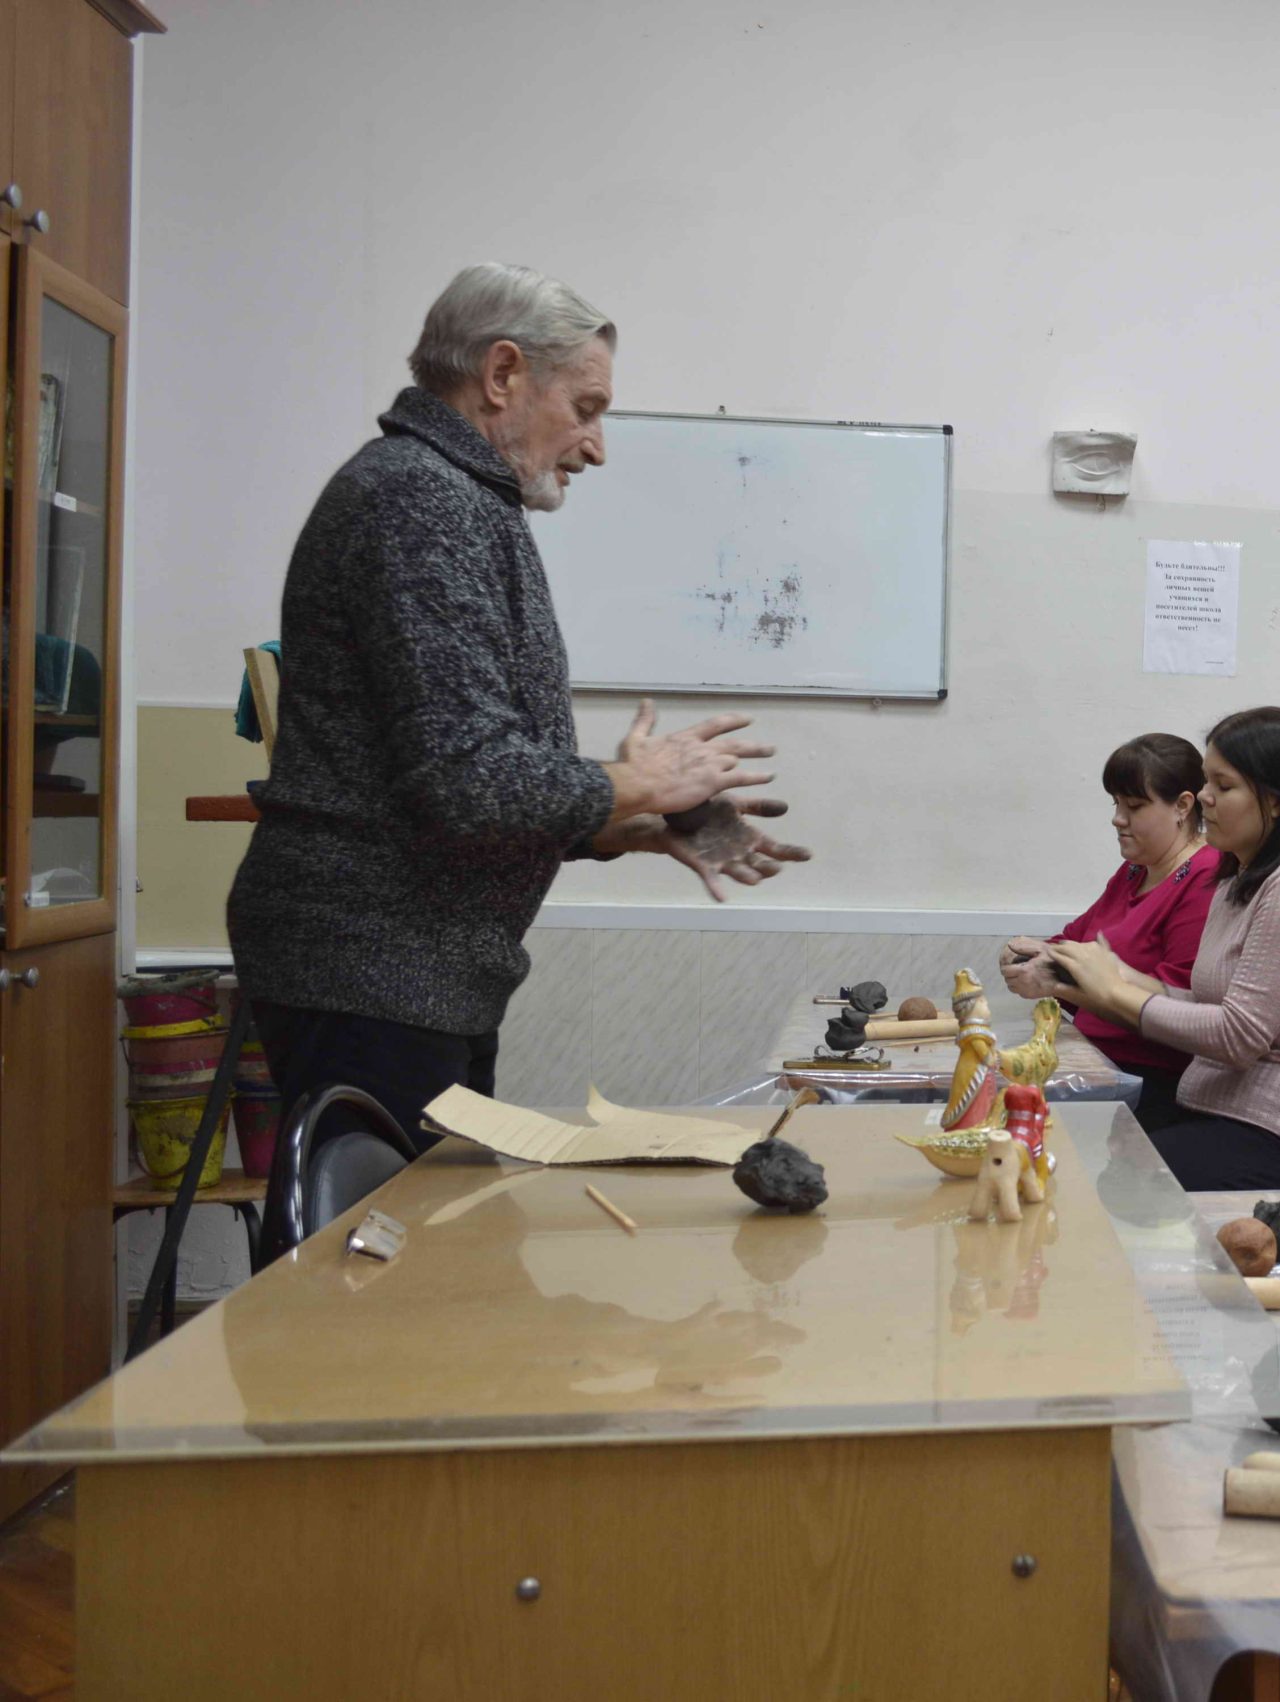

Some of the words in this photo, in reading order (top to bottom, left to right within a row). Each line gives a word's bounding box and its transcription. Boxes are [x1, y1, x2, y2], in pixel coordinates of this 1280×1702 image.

[1155, 561, 1180, 570] Будьте
[1173, 575, 1216, 583] сохранность
[1165, 584, 1191, 592] личных
[1155, 614, 1212, 622] ответственность
